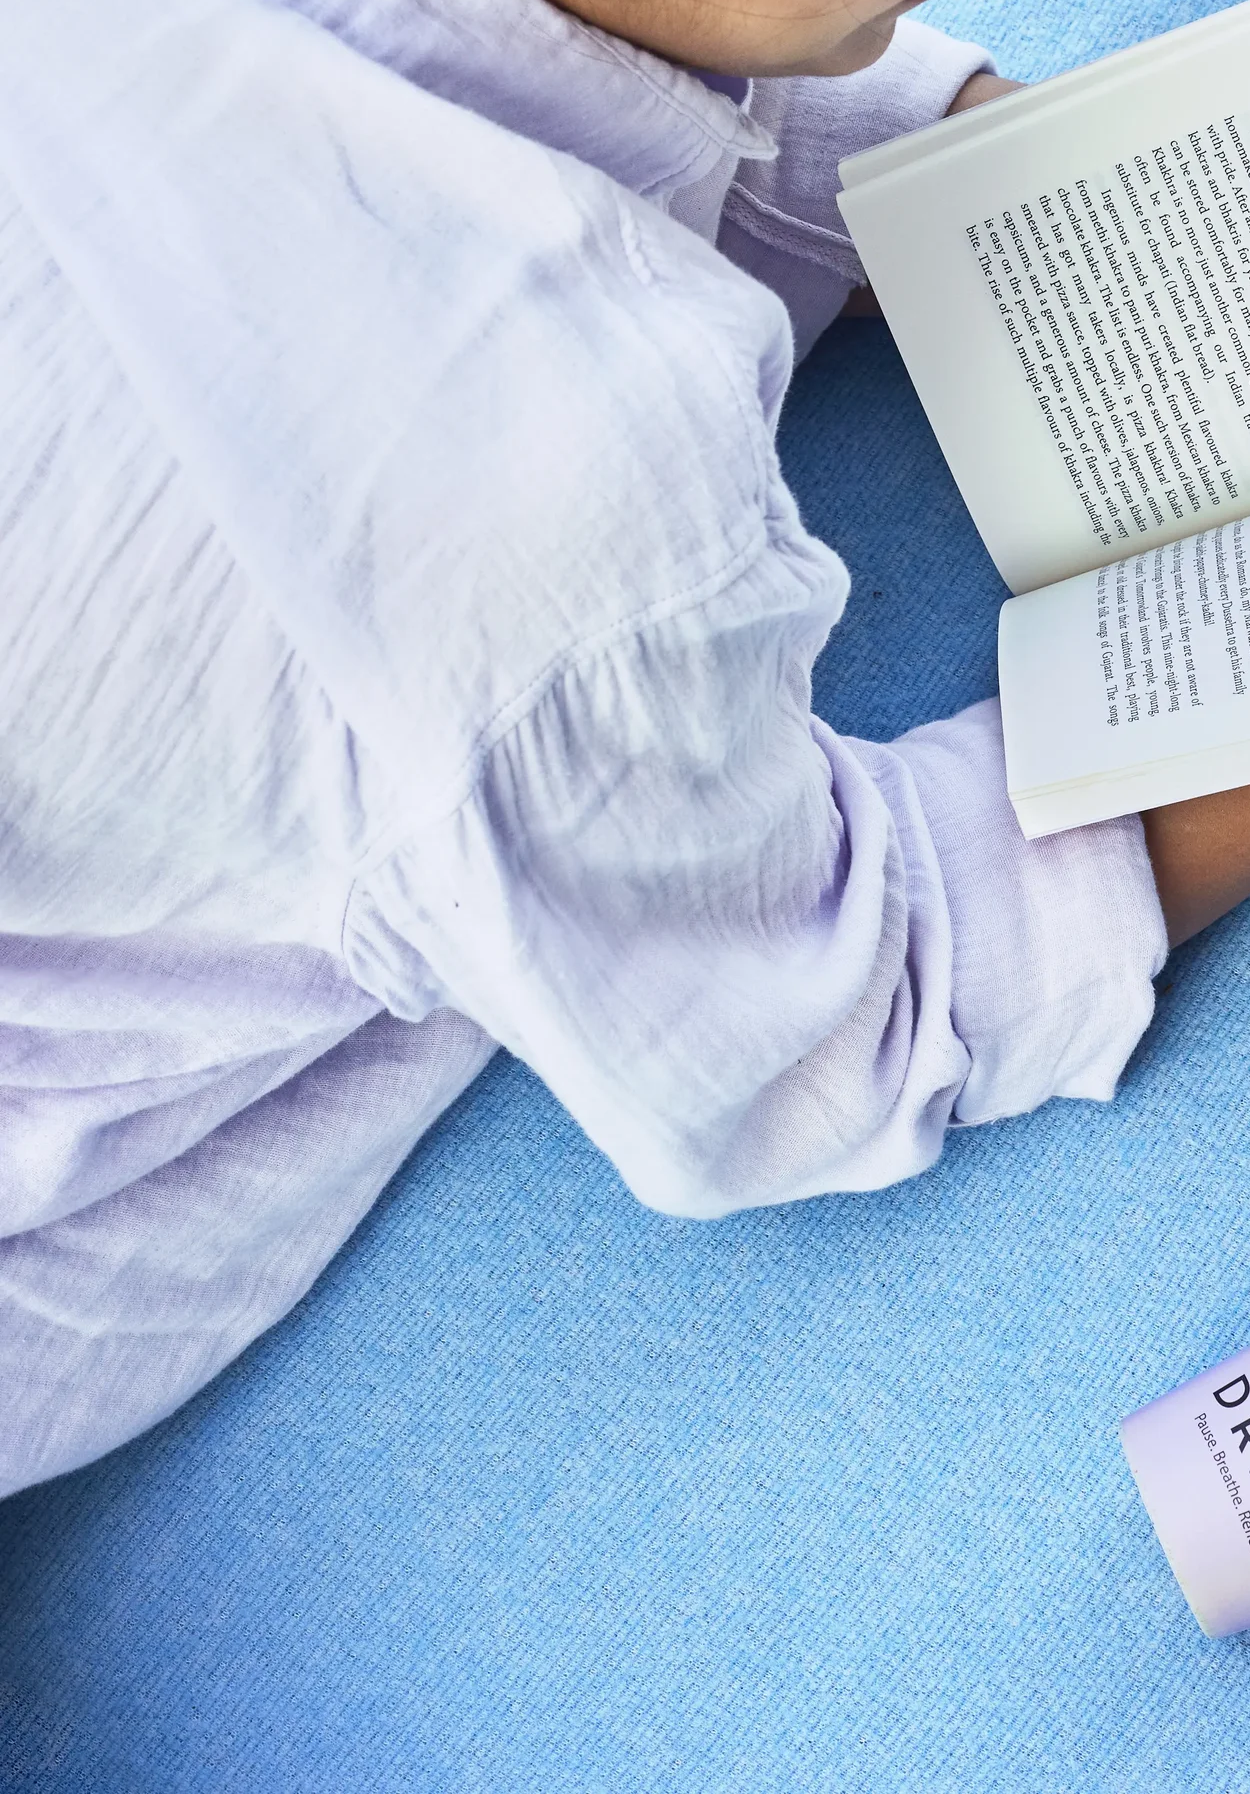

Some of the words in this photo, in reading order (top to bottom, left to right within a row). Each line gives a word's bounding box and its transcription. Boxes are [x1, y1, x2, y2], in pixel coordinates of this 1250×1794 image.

[964, 223, 982, 253] bite.
[976, 250, 994, 279] The
[1113, 161, 1145, 219] substitute
[1137, 217, 1154, 237] for
[1146, 237, 1174, 281] chapati
[1162, 279, 1190, 324] (Indian
[1182, 322, 1199, 345] flat
[1191, 341, 1217, 385] bread).
[986, 277, 1004, 302] rise
[997, 301, 1015, 317] of
[1003, 316, 1025, 346] such
[1099, 187, 1132, 247] Ingenious
[1125, 249, 1150, 288] minds
[1142, 289, 1162, 321] have
[1156, 323, 1185, 366] created
[1172, 368, 1206, 417] plentiful
[1197, 418, 1229, 468] flavoured
[1218, 467, 1240, 500] khakra
[1015, 345, 1045, 395] multiple
[1036, 394, 1064, 441] flavours
[1056, 440, 1074, 455] of
[1061, 452, 1086, 491] khakra
[1078, 489, 1106, 535] including
[1098, 531, 1113, 547] the
[1095, 586, 1108, 596] to
[1096, 593, 1110, 607] the
[1096, 604, 1111, 621] folk
[1094, 618, 1110, 640] songs
[1099, 639, 1115, 651] of
[1098, 648, 1118, 684] Gujarat.
[1105, 683, 1122, 703] The
[1105, 703, 1121, 728] songs
[1194, 1412, 1217, 1451] Pause.
[1212, 1450, 1243, 1508] Breathe.
